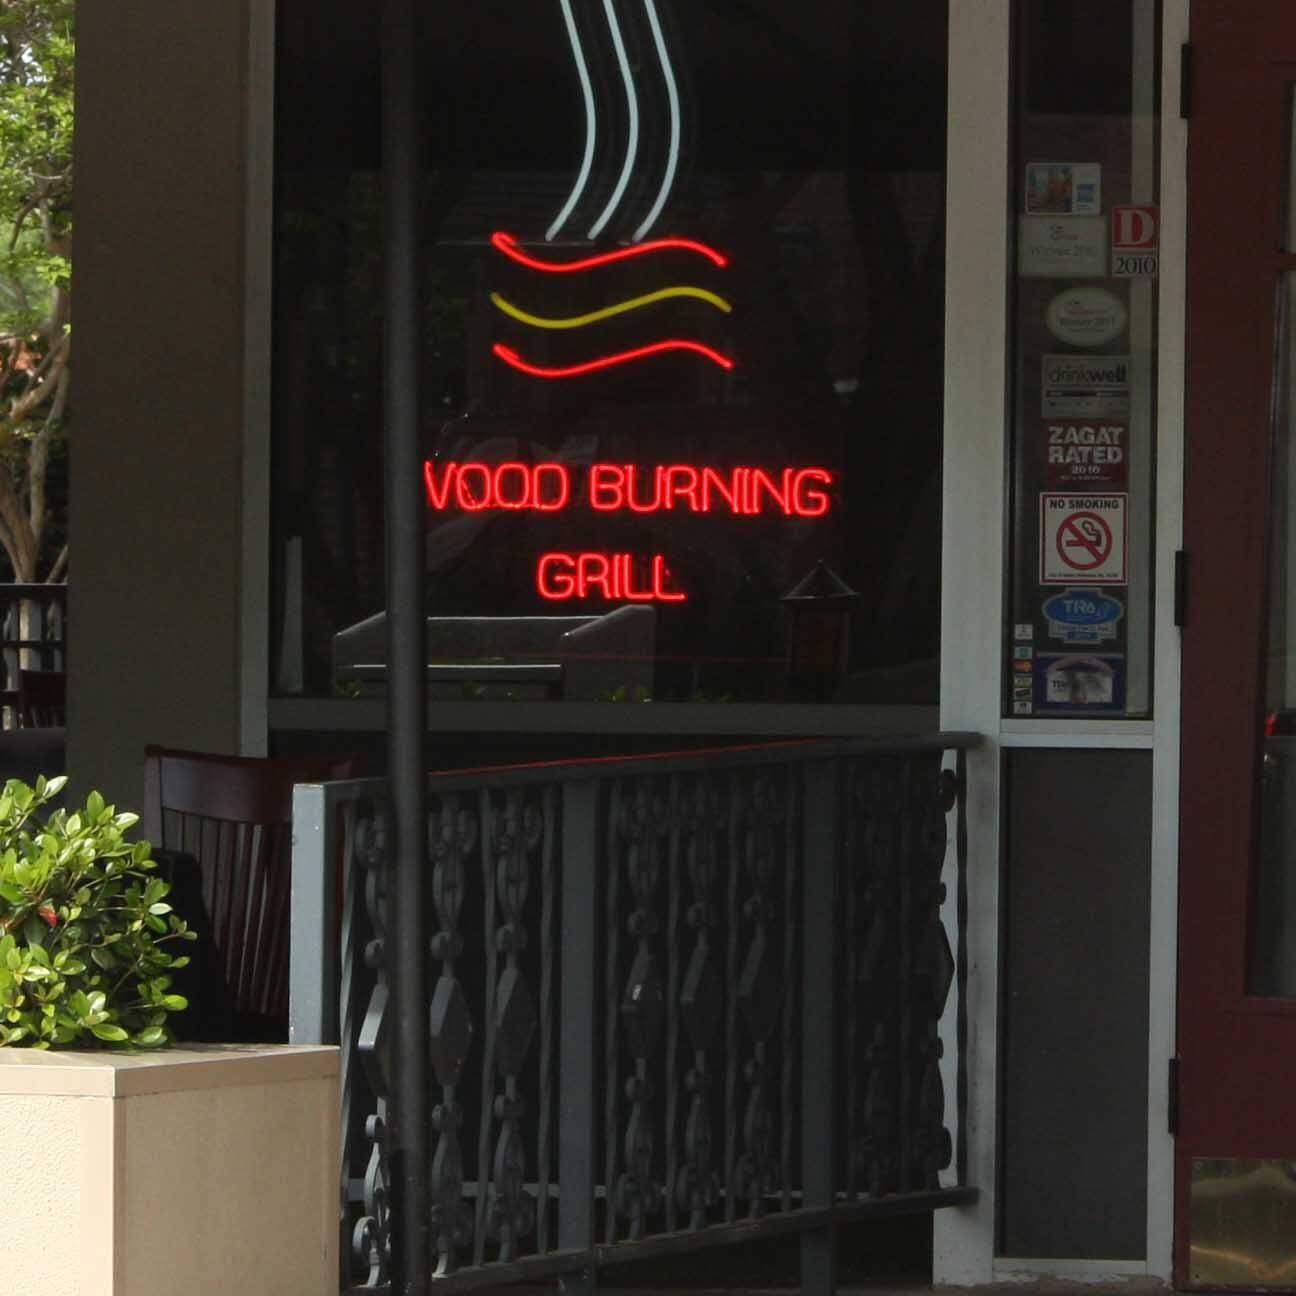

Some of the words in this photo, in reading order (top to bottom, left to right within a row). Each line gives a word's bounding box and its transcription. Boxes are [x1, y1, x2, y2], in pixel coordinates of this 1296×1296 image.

[1118, 208, 1154, 246] D
[1114, 256, 1156, 274] 2010
[1047, 426, 1125, 445] ZAGAT
[1048, 446, 1124, 464] RATED
[589, 464, 833, 517] BURNING
[1050, 499, 1065, 509] NO
[1068, 499, 1120, 509] SMOKING
[536, 552, 688, 602] GRILL
